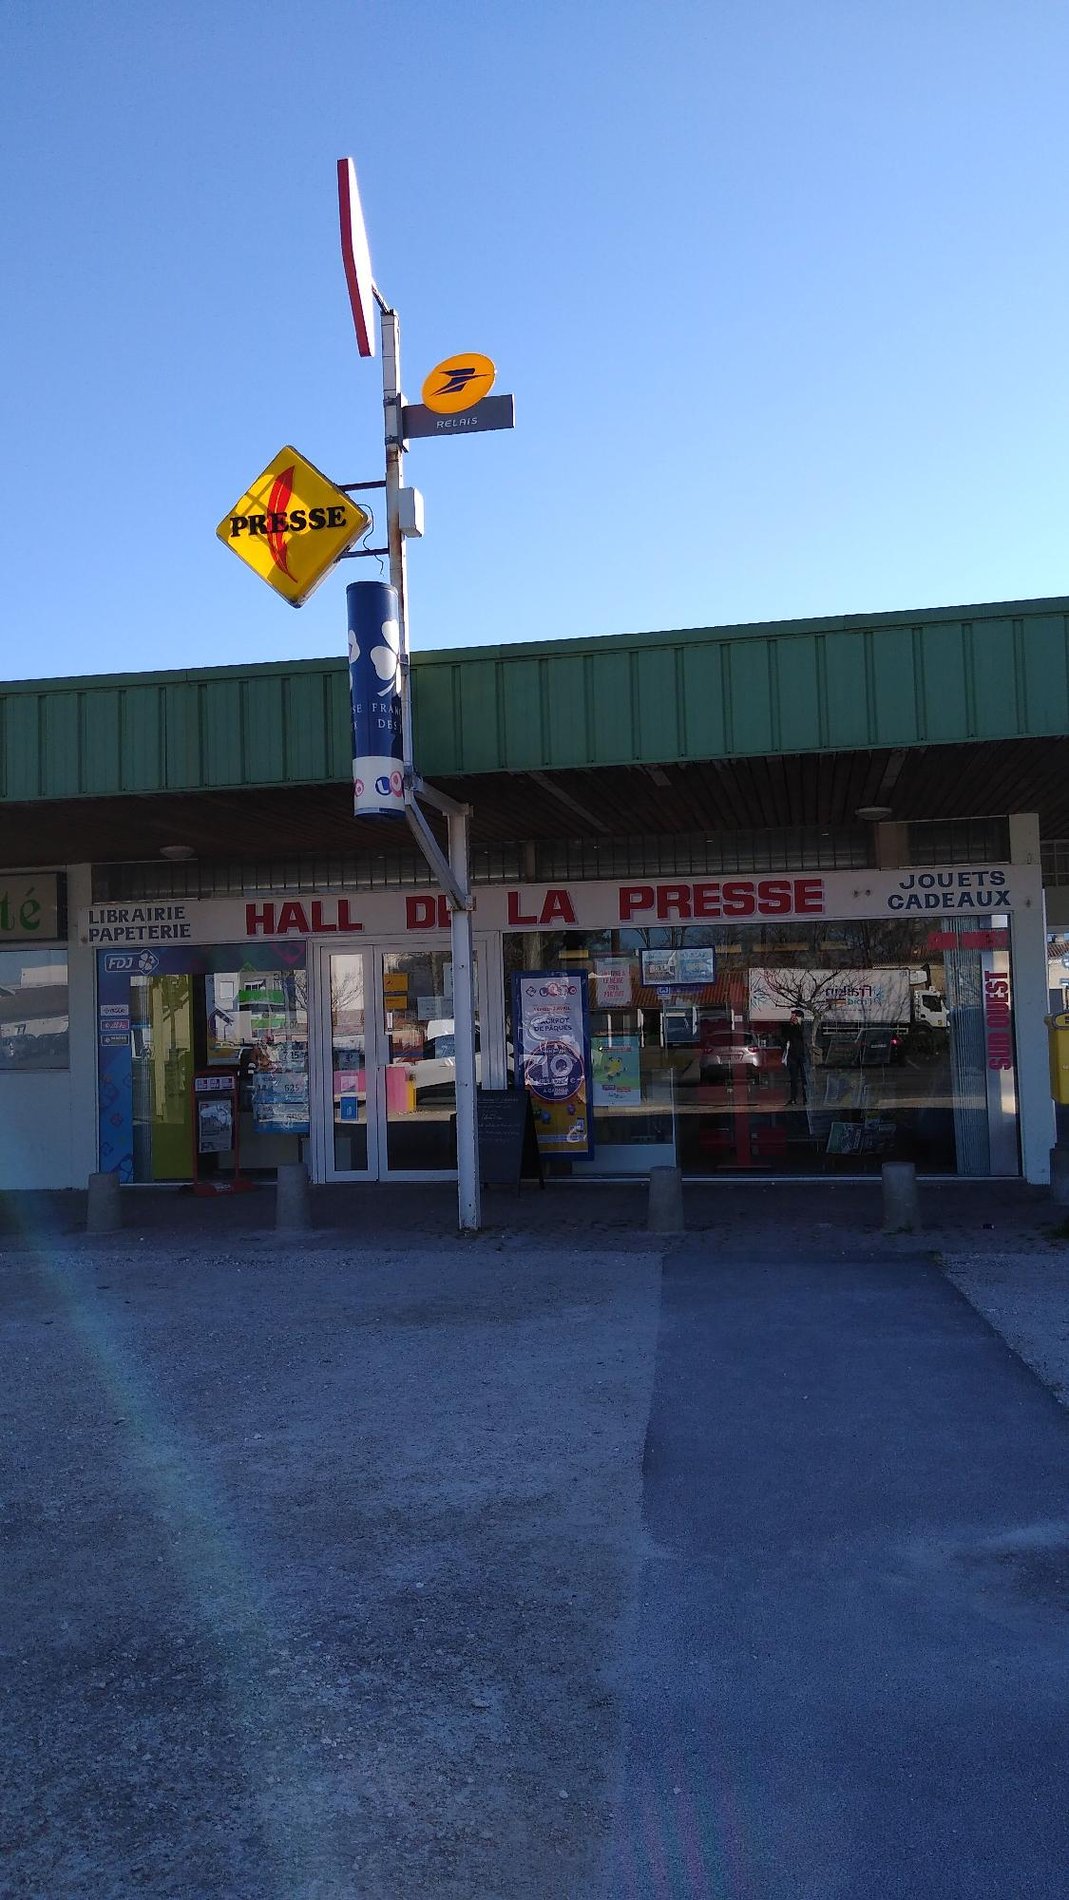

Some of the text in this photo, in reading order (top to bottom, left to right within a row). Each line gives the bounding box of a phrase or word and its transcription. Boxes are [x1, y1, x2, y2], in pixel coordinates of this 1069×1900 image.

[436, 416, 478, 429] RELAIS
[230, 506, 347, 538] PRESSE
[899, 870, 1005, 890] JOUETS
[246, 899, 363, 936] HALL
[507, 889, 576, 925] LA
[619, 879, 823, 921] PRESSE
[887, 890, 1011, 910] CADEAUX
[88, 906, 186, 925] LIBRAIRIE
[88, 923, 191, 943] PAPETERIE
[108, 957, 134, 969] FDJ
[984, 970, 1012, 1071] SUD OUEST
